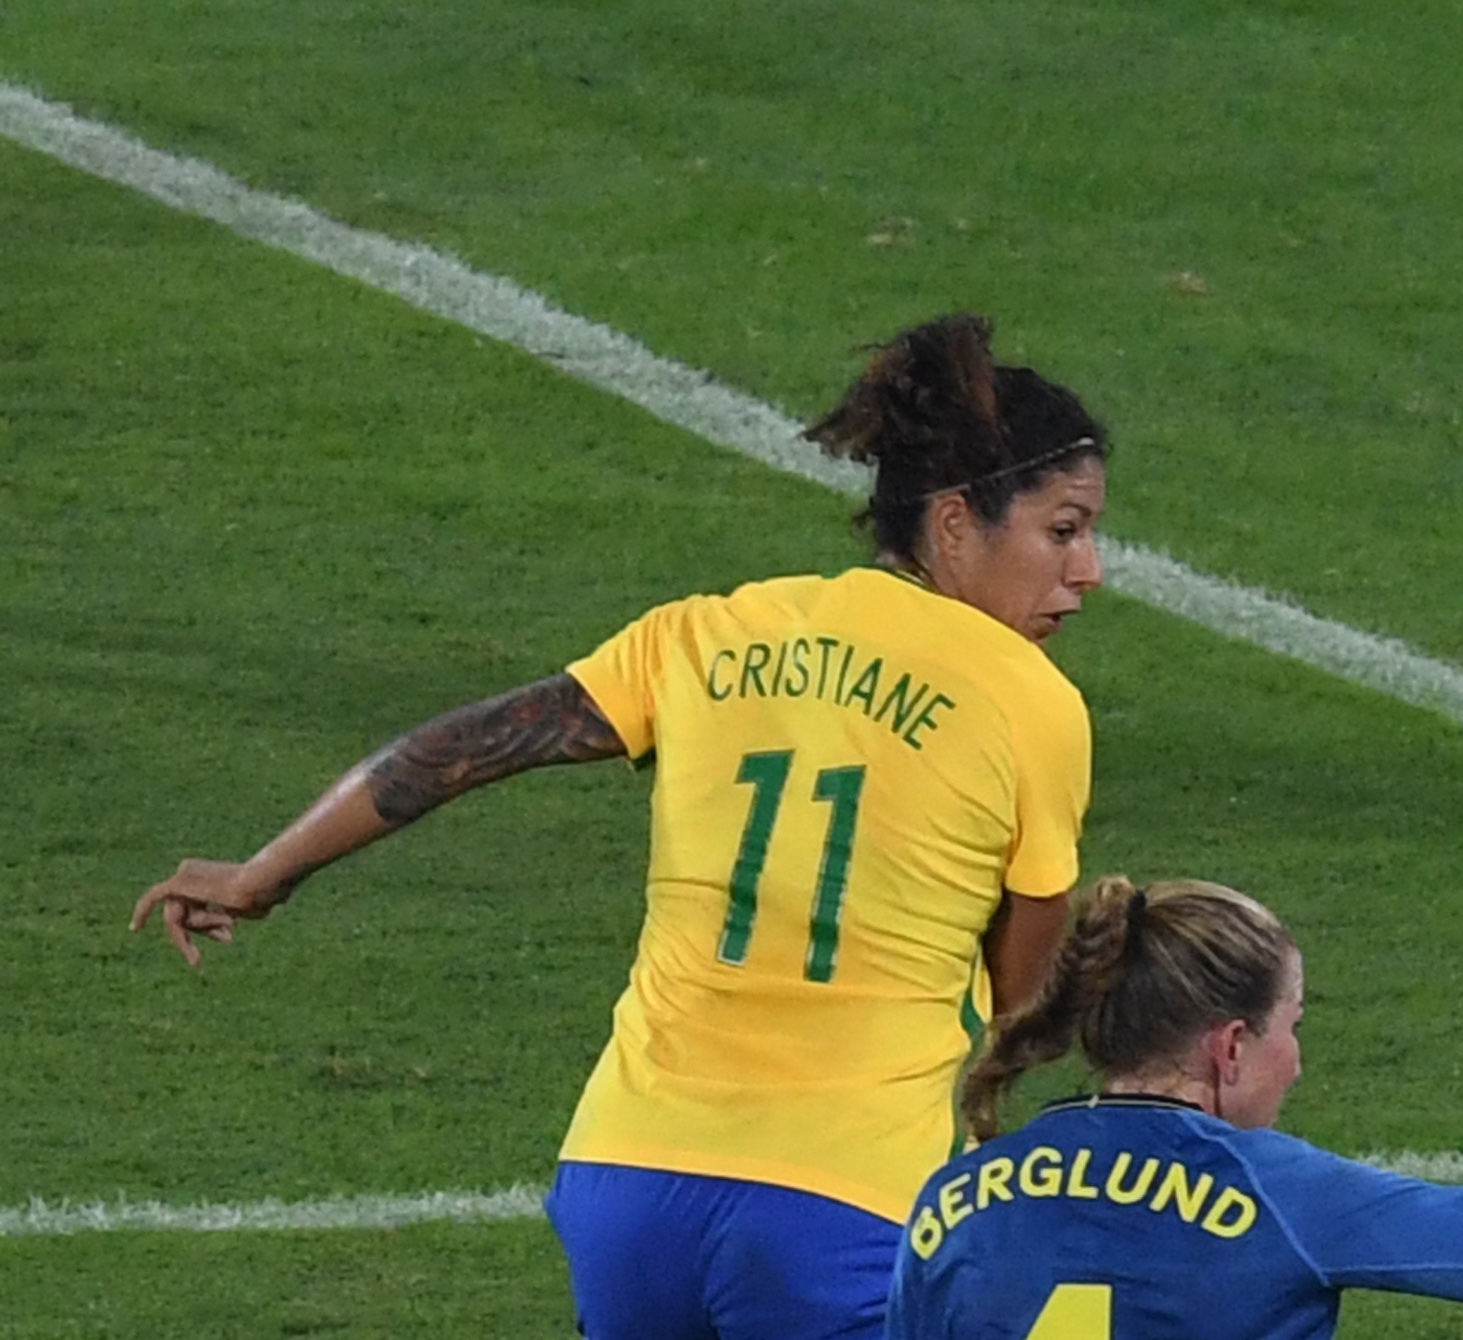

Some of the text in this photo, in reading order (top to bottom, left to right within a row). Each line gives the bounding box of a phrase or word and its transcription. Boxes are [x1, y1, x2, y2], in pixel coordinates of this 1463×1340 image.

[706, 636, 956, 751] CRISTIANE
[716, 748, 867, 985] 11
[909, 1146, 1258, 1261] BERGLUND
